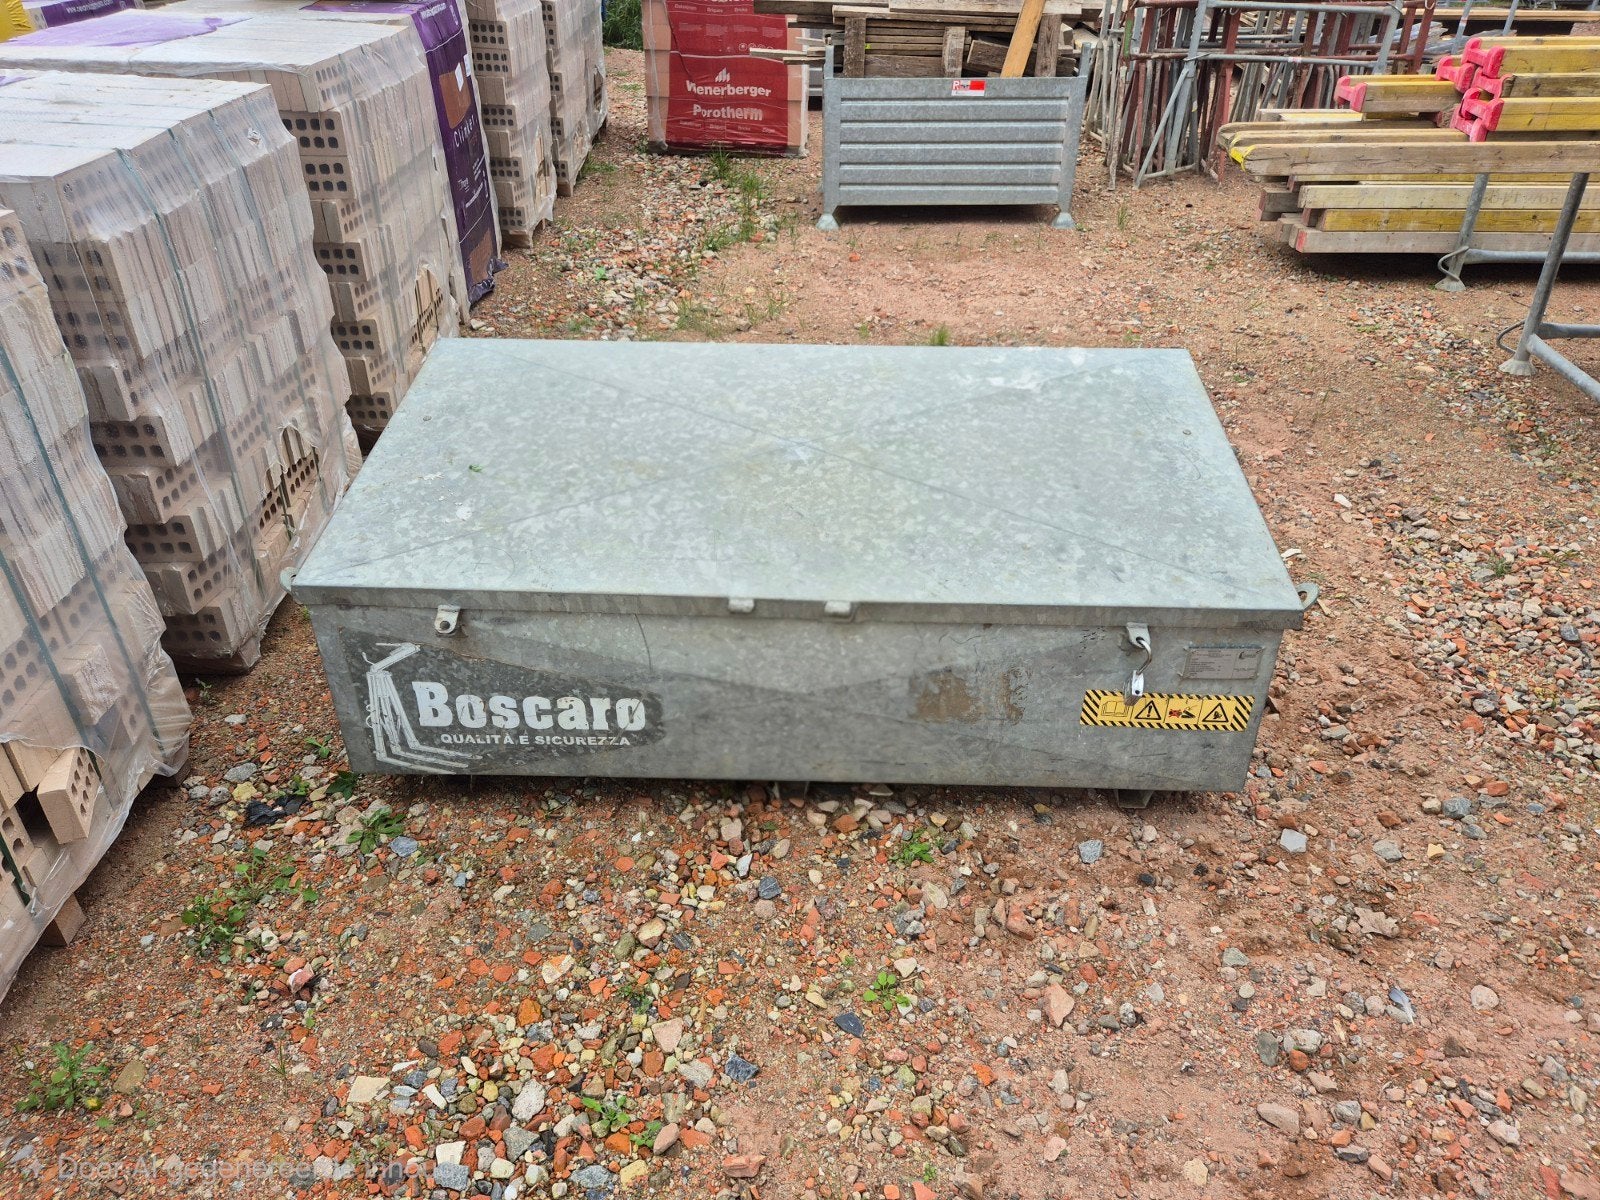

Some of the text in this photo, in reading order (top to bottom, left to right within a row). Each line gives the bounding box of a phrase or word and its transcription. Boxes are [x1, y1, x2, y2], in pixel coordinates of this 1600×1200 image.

[693, 104, 762, 121] Porotherm
[412, 681, 646, 731] Boscaro
[534, 735, 630, 746] SICUREZZA
